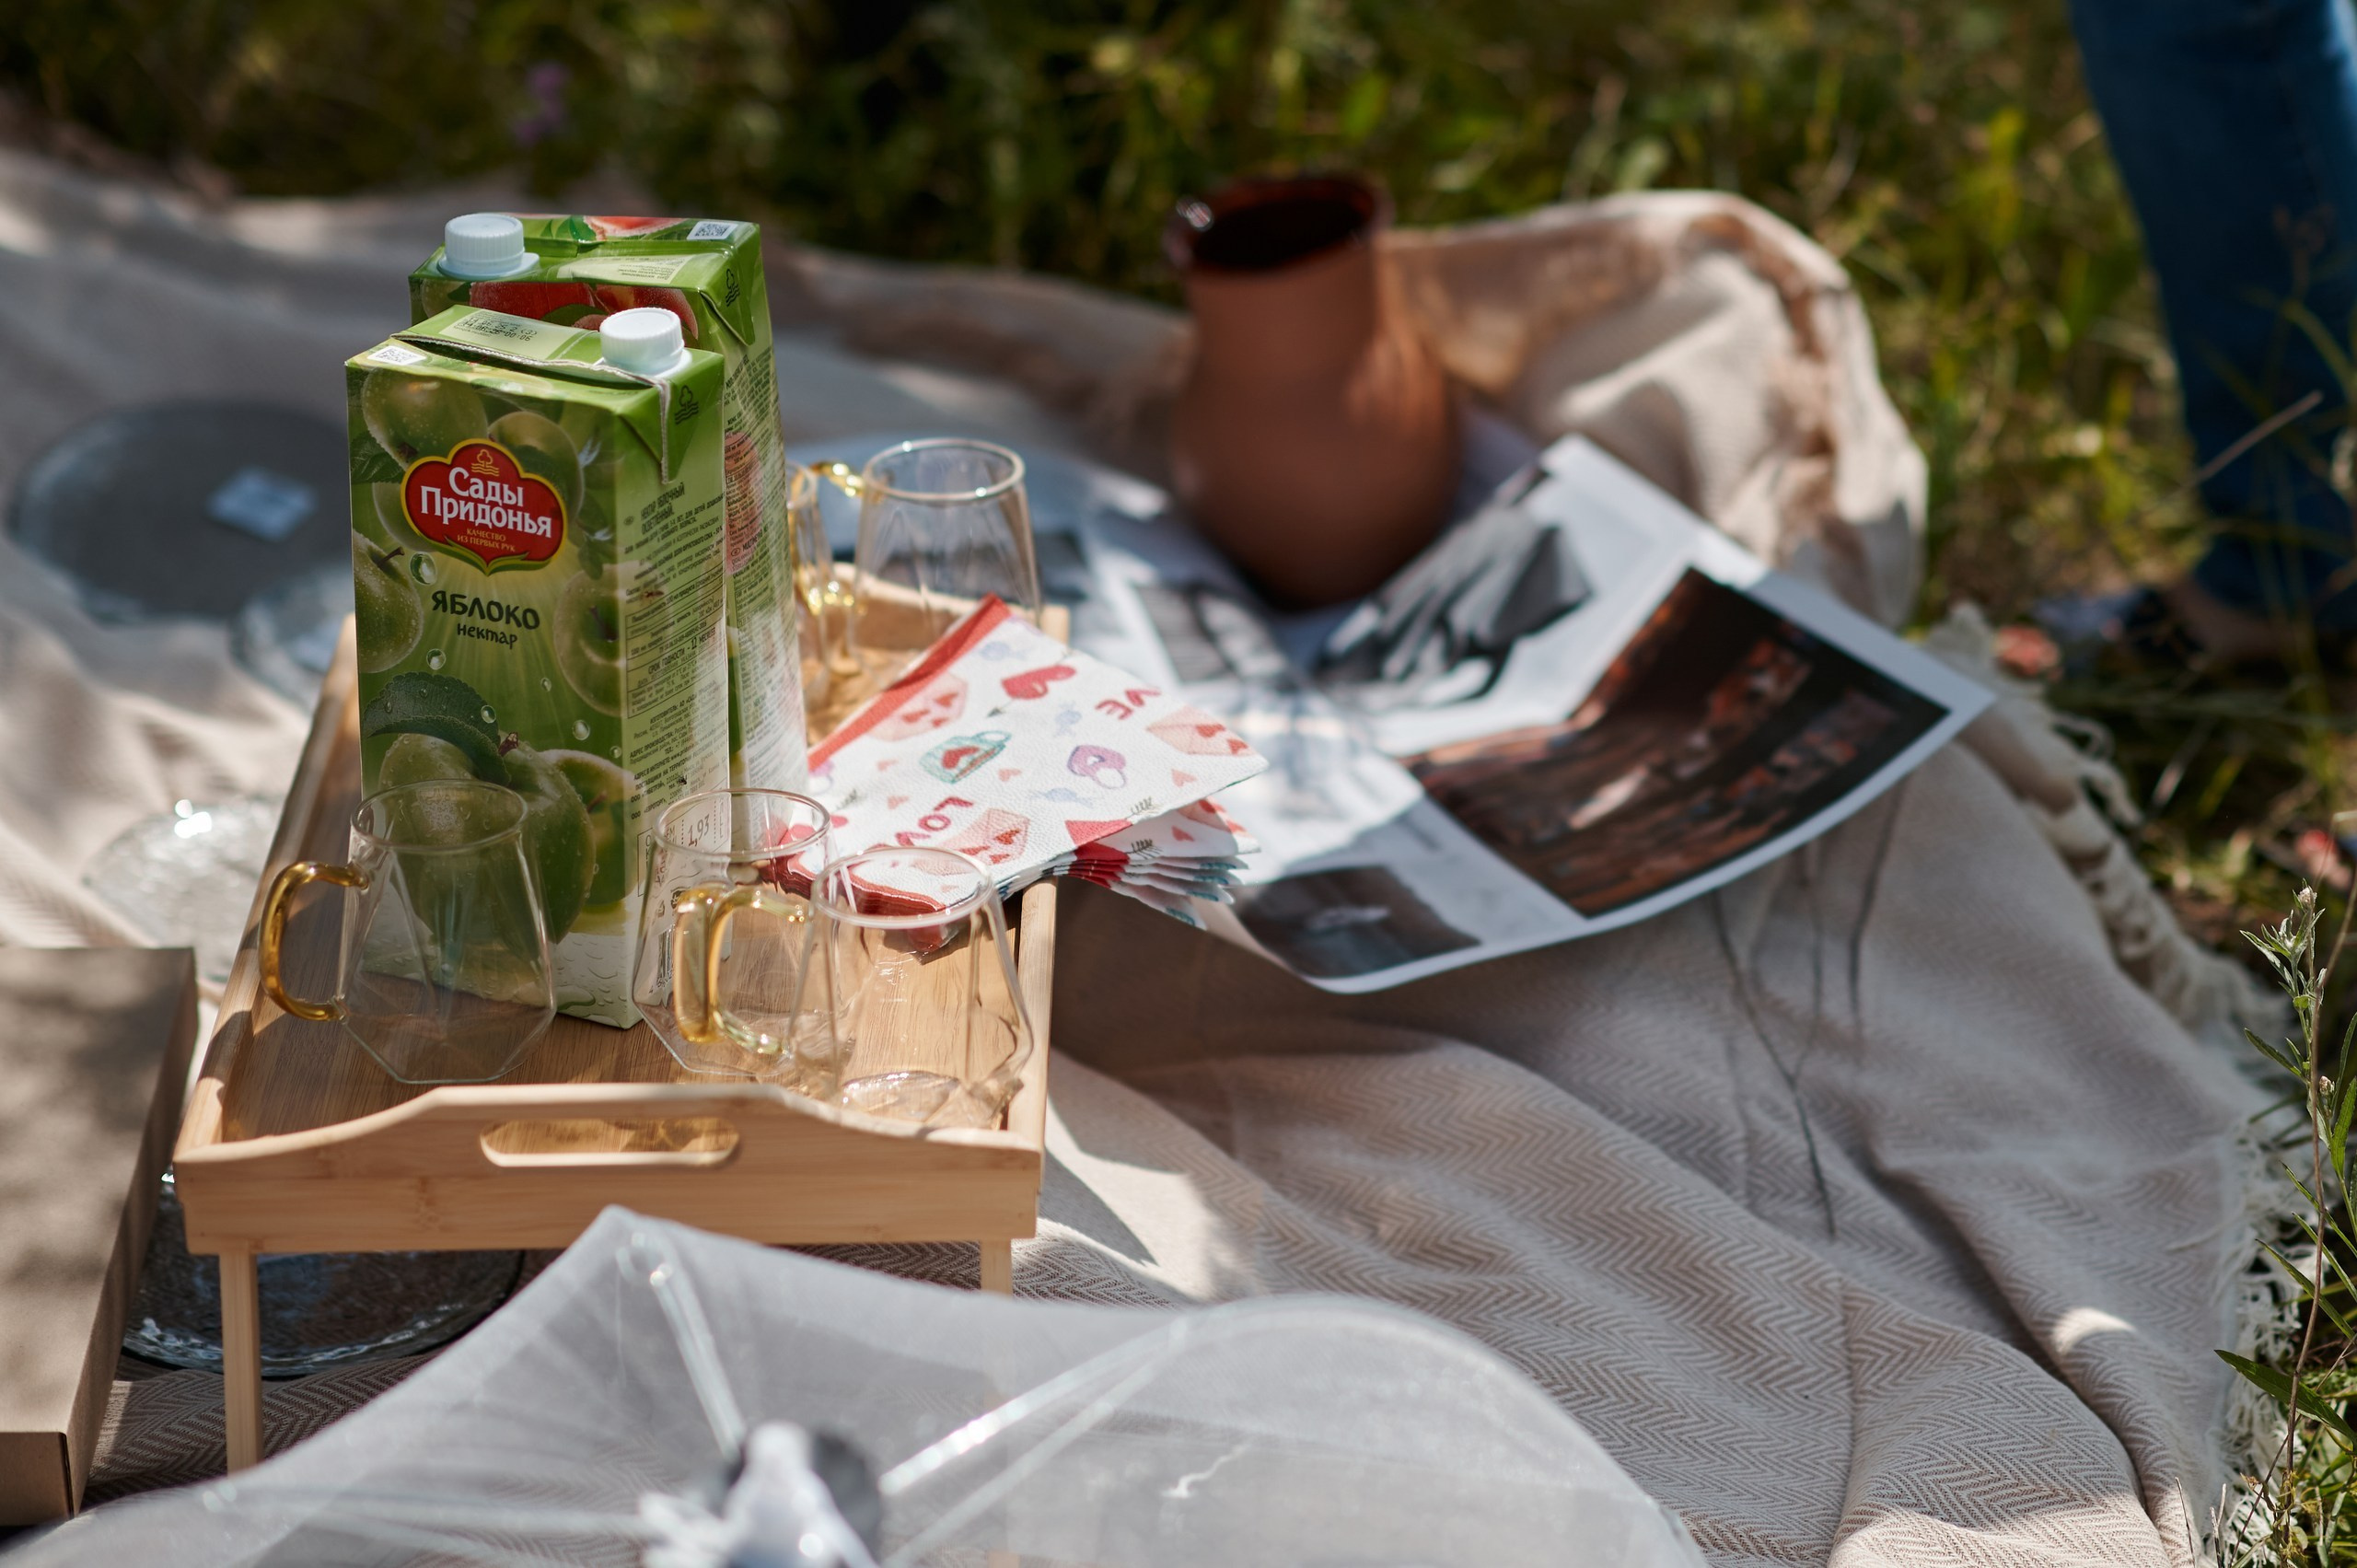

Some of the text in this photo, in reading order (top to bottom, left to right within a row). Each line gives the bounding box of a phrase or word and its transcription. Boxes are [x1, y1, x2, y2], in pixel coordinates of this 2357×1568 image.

[448, 466, 524, 506] Сады
[421, 485, 552, 539] Придонья
[457, 534, 516, 552] ИЗ ПЕРВЫХ РУК
[466, 528, 506, 542] КАЧЕСТВО
[431, 589, 540, 631] ЯБЛОКО
[457, 622, 518, 650] нектар
[691, 636, 698, 650] 12
[688, 814, 711, 848] 1,93
